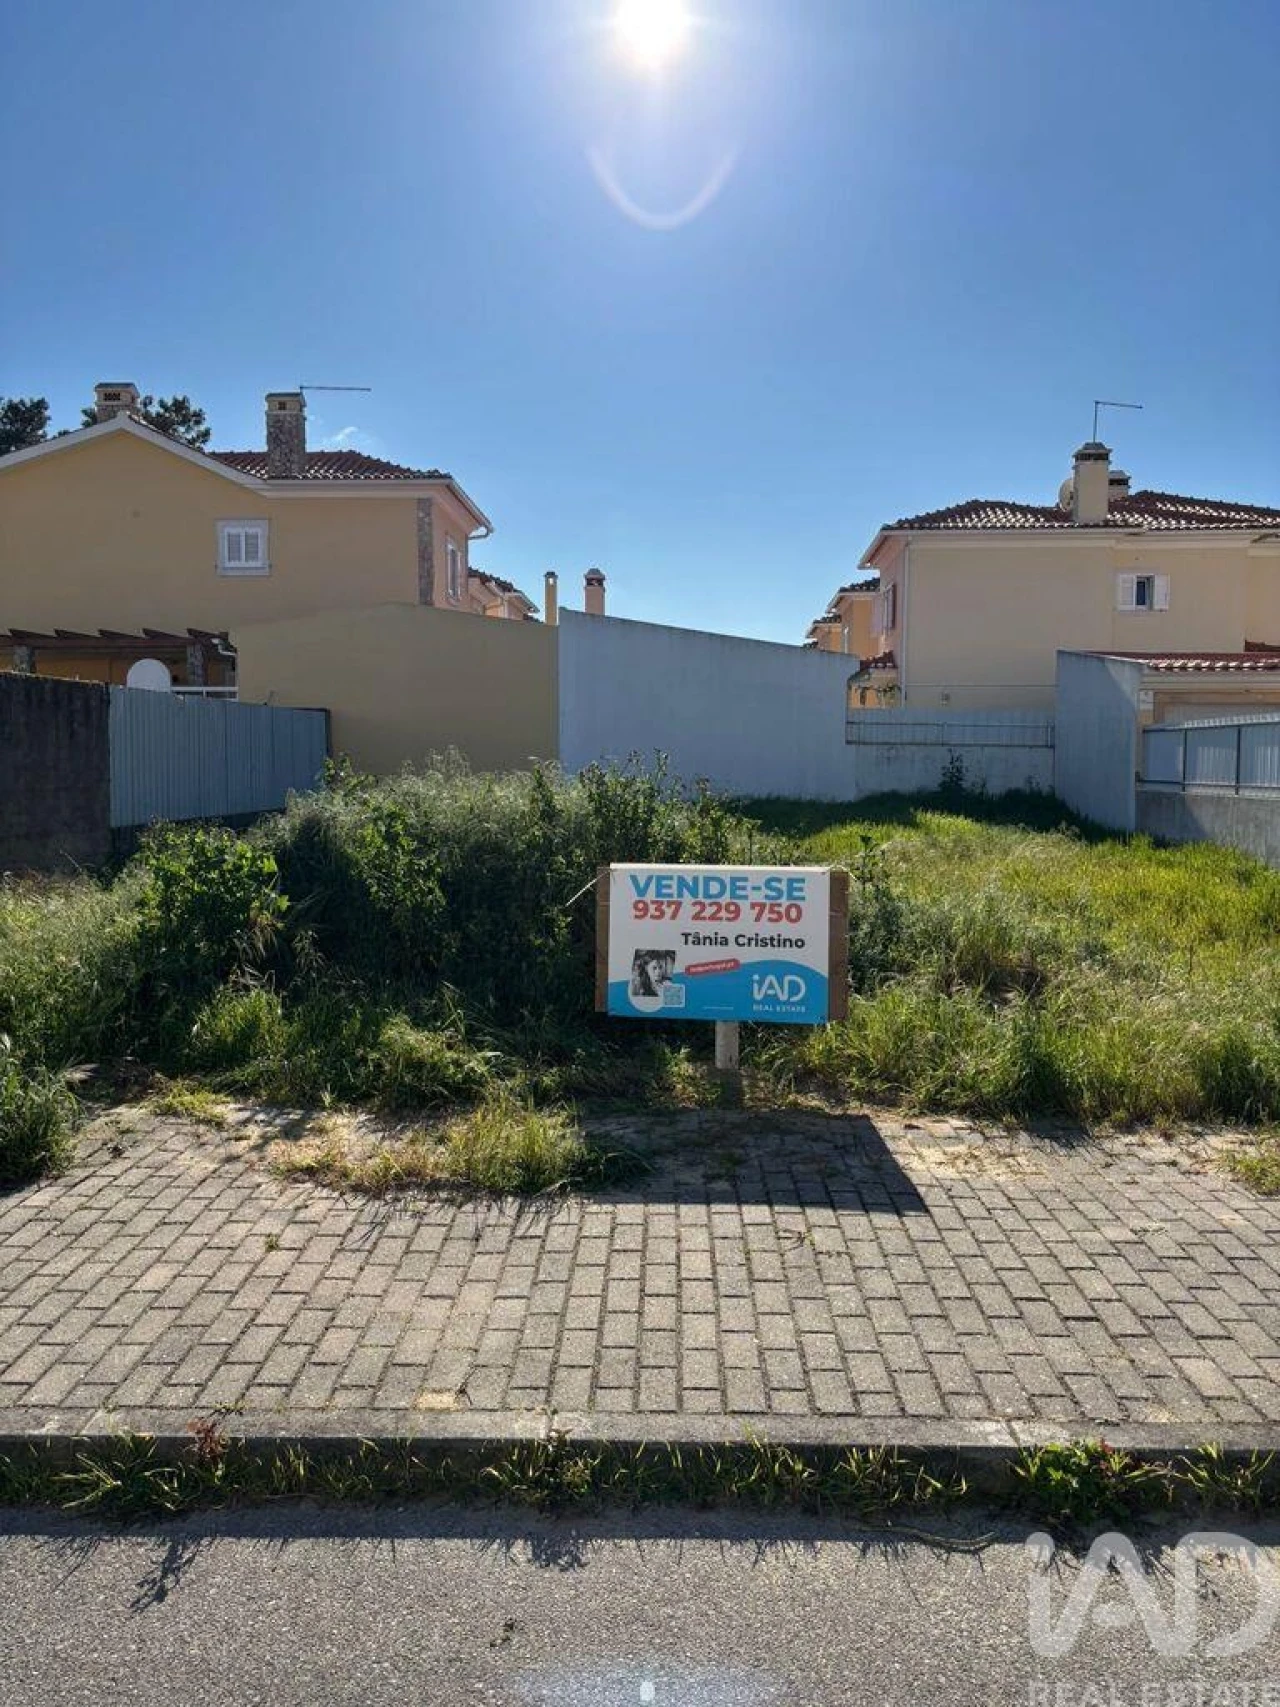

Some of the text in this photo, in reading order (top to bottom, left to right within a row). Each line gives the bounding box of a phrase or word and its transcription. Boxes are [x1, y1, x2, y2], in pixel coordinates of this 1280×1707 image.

[630, 874, 806, 901] VENDE-SE
[633, 900, 802, 923] 937 229 750
[681, 932, 806, 949] Tânia Cristino
